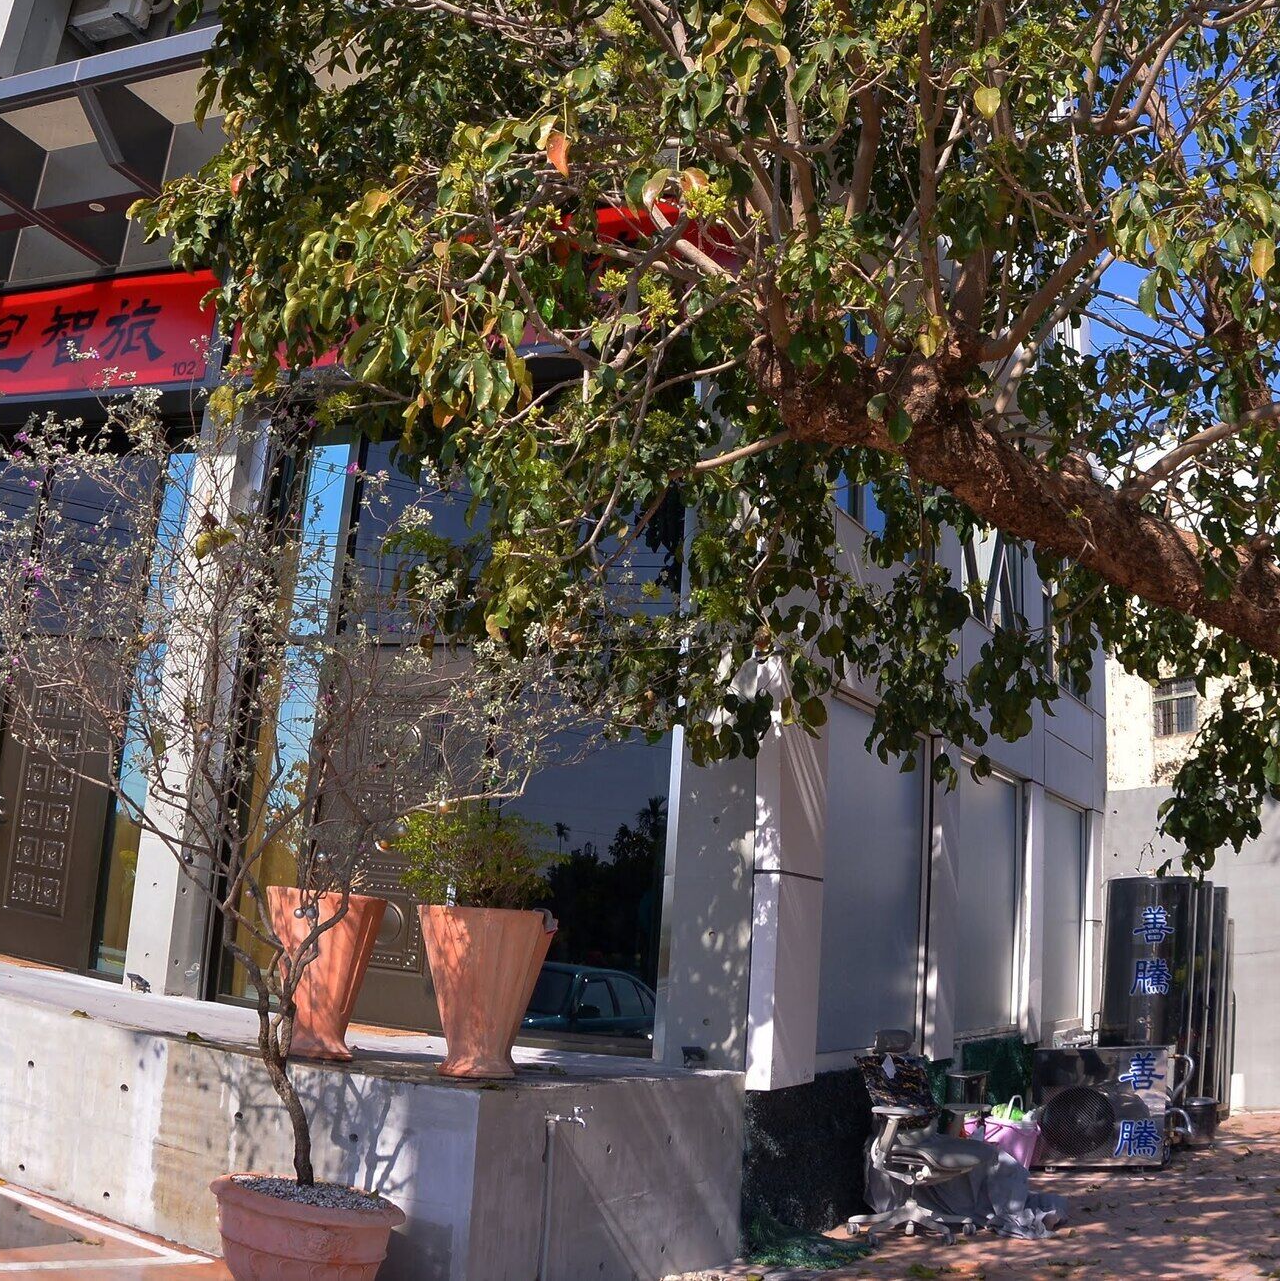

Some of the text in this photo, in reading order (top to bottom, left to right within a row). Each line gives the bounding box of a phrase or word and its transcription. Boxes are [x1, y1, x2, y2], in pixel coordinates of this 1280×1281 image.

[172, 361, 197, 376] 102
[1130, 905, 1175, 995] 善騰
[1114, 1052, 1165, 1158] 善騰
